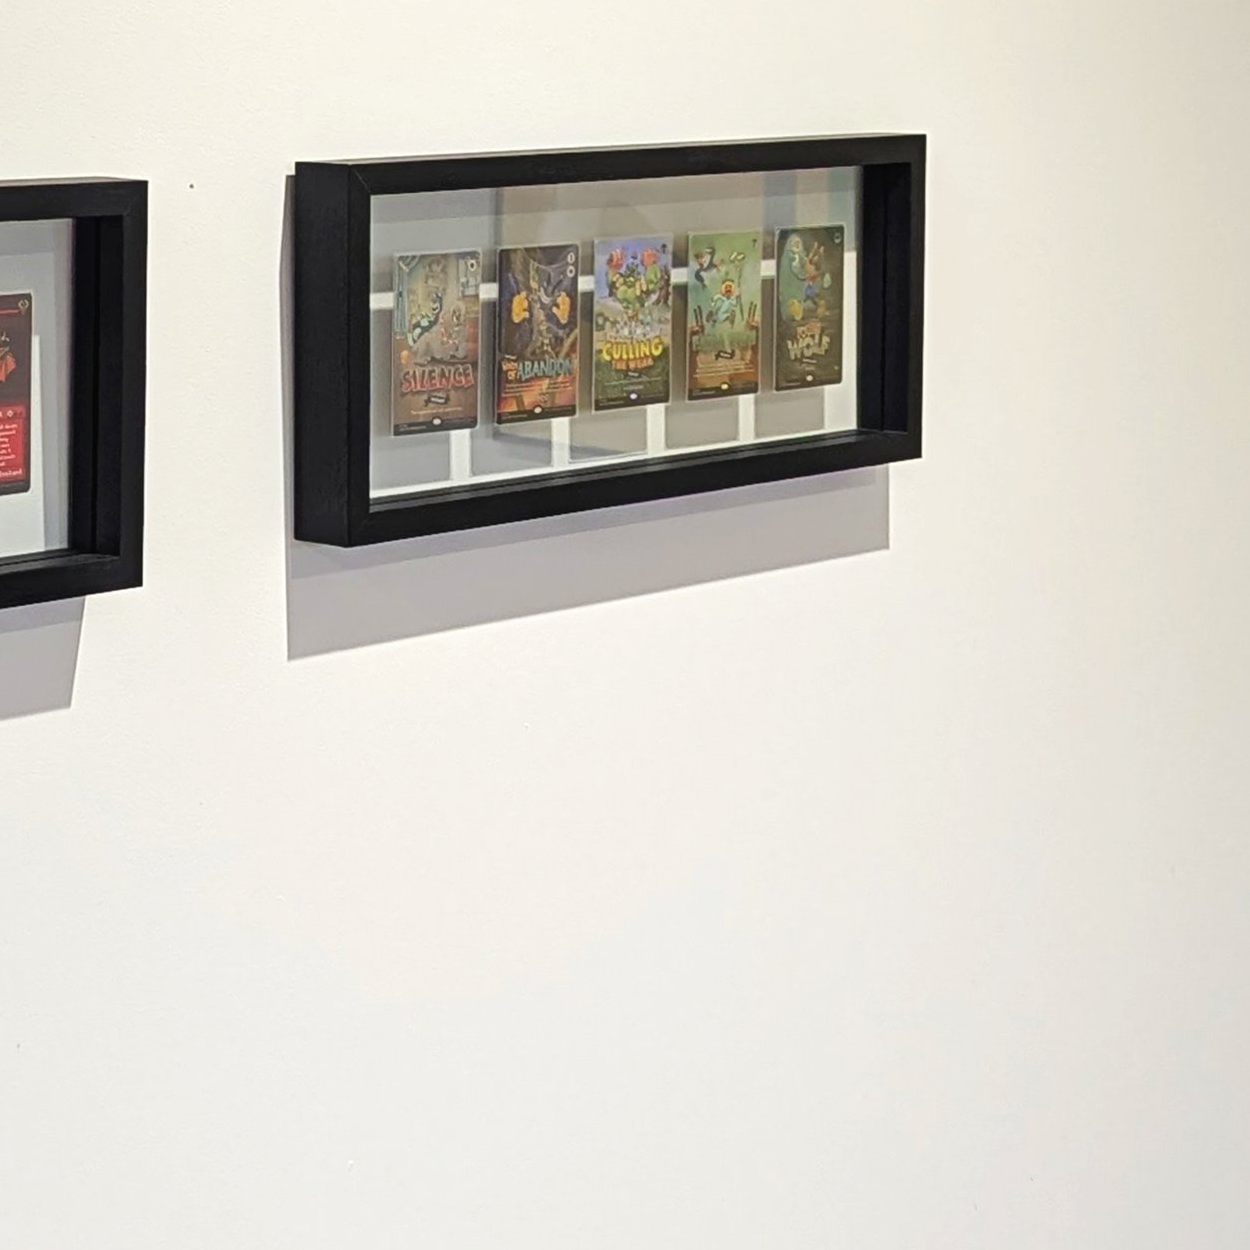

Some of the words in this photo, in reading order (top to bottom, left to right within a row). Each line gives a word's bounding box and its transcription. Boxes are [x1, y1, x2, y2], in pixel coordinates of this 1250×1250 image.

[602, 335, 664, 362] CULLING
[786, 333, 831, 361] WOLF
[401, 363, 475, 393] SILENCE
